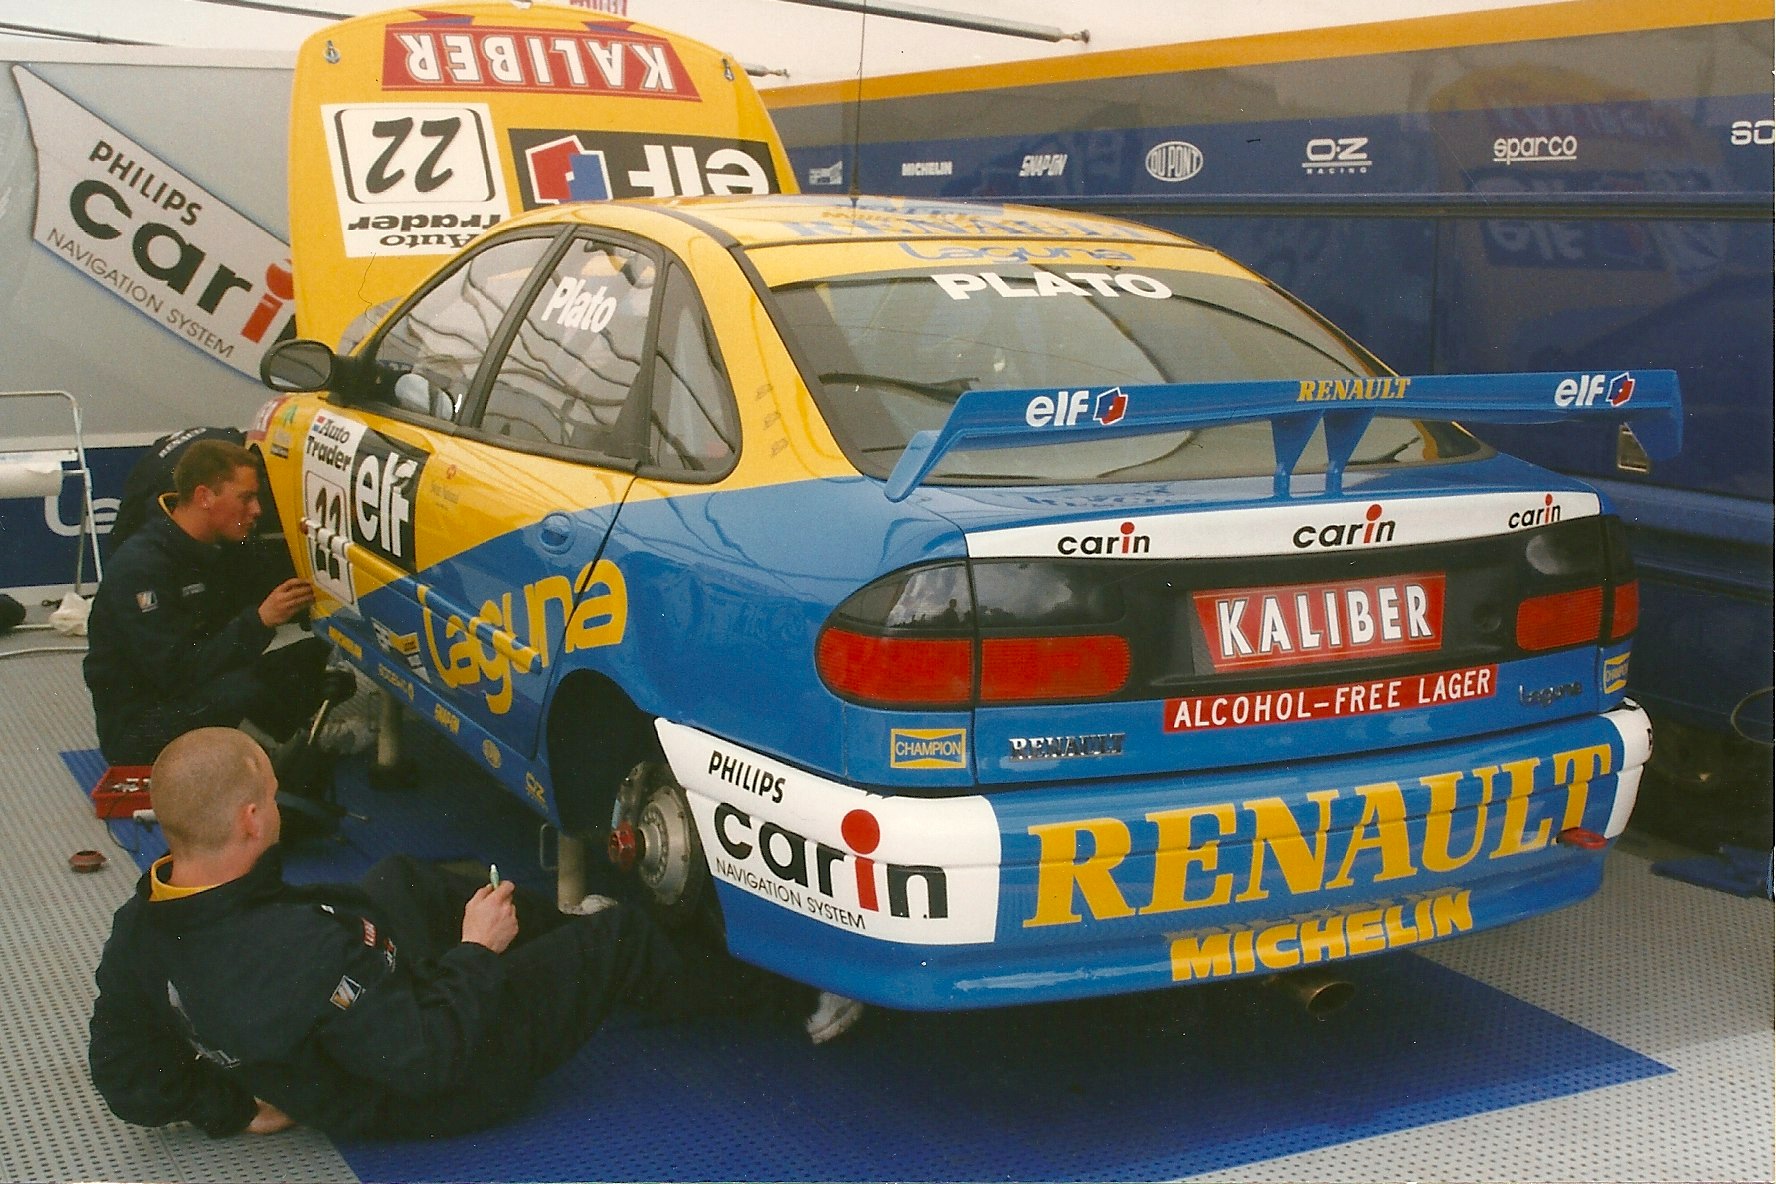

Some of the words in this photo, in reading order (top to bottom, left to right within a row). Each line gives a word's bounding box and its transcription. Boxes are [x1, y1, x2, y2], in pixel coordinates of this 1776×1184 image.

[399, 33, 676, 92] KALIBER
[365, 117, 461, 194] 22
[628, 144, 769, 197] elf
[1494, 135, 1577, 165] sparco
[88, 140, 204, 227] PHILIPS
[348, 214, 501, 232] Trader
[380, 233, 480, 249] Auto
[69, 179, 297, 344] cari
[899, 242, 1136, 263] Laguna
[46, 227, 165, 314] NAVIGATION
[166, 308, 235, 359] SYSTEM
[541, 276, 617, 333] Plato
[931, 272, 1173, 300] PLATO
[1025, 391, 1089, 427] elf
[1296, 377, 1411, 402] RENAULT
[1554, 375, 1605, 407] elf
[306, 436, 352, 471] Trader
[319, 418, 350, 444] Auto
[356, 452, 418, 557] elf
[1293, 504, 1395, 549] carin
[1509, 494, 1560, 528] carin
[1058, 522, 1151, 555] carin
[416, 559, 628, 715] Laguna
[1216, 583, 1432, 660] KALIBER
[1173, 681, 1401, 729] ALCOHOL-FREE
[1418, 667, 1491, 704] LAGER
[896, 739, 961, 757] CHAMPION
[1009, 734, 1125, 760] RENAULT
[708, 750, 786, 804] PHILIPS
[714, 802, 949, 919] carin
[1023, 745, 1611, 928] RENAULT
[716, 857, 802, 909] NAVIGATION
[806, 899, 866, 930] SYSTEM
[1170, 890, 1473, 982] MICHELIN
